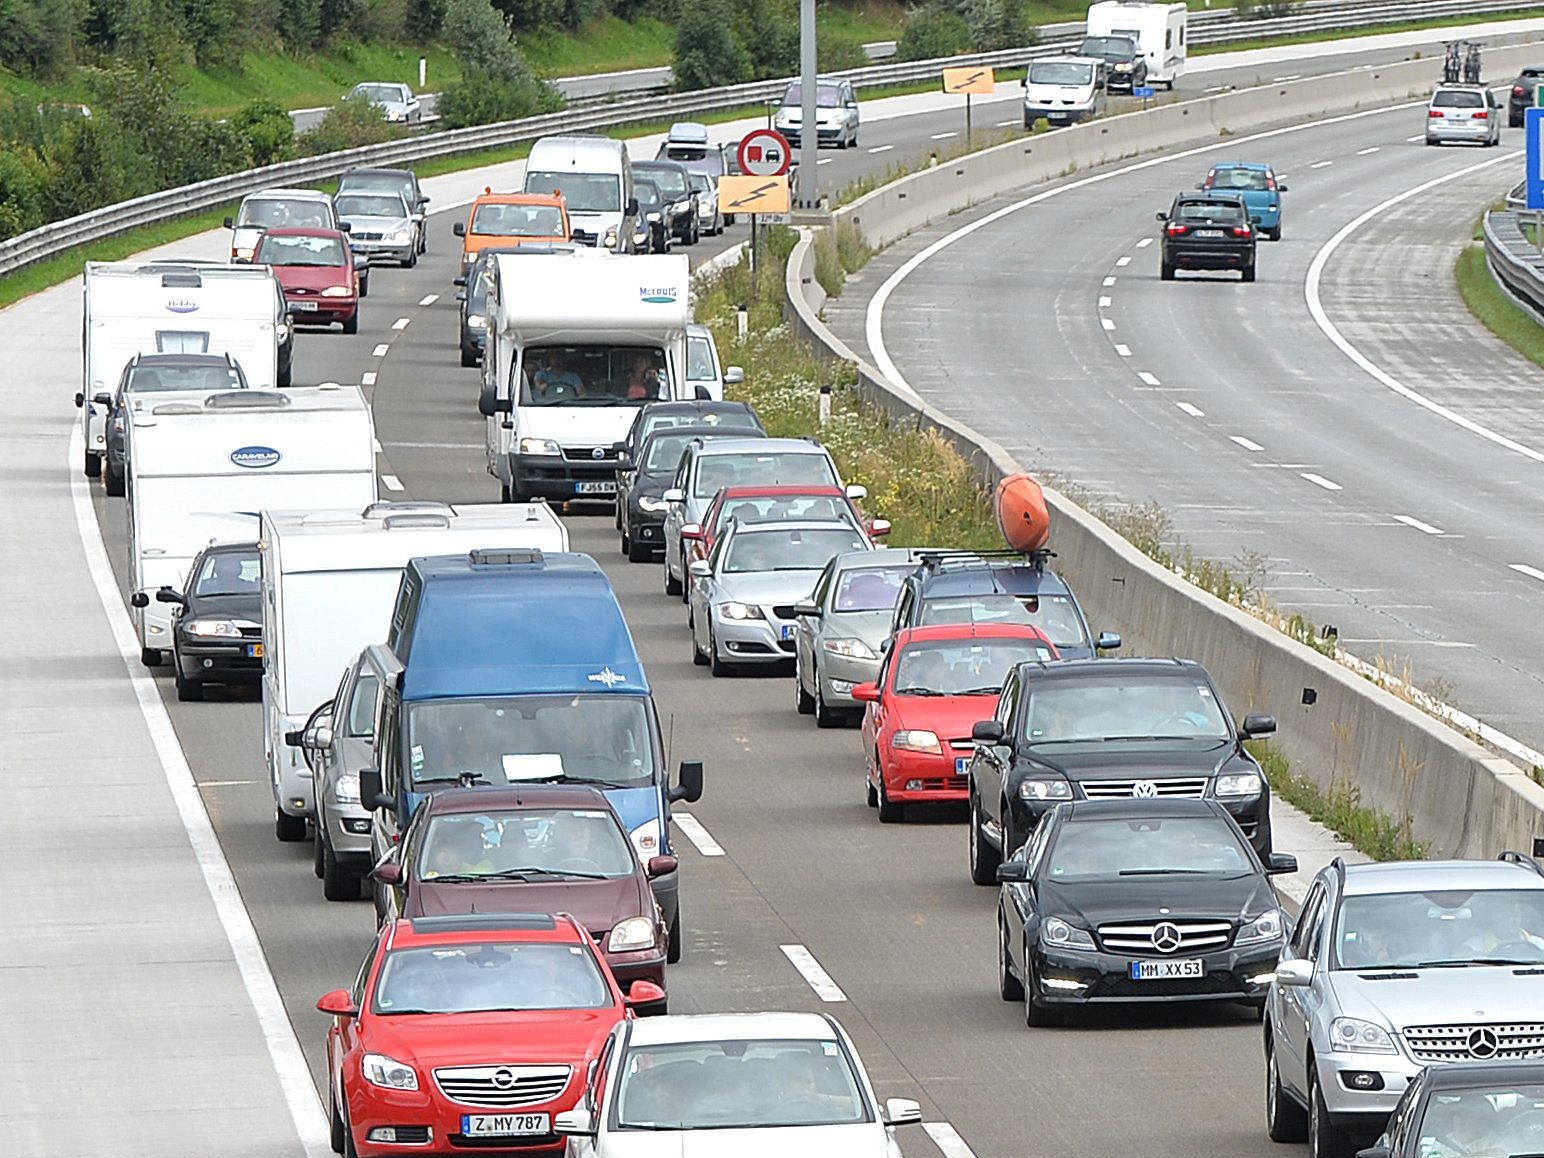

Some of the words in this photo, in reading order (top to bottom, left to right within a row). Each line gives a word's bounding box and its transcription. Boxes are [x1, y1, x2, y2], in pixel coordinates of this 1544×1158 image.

[1141, 964, 1159, 976] MM
[1165, 963, 1182, 976] XX
[1184, 962, 1200, 975] 53
[476, 1117, 485, 1131] Z
[494, 1117, 512, 1131] MY
[516, 1116, 543, 1130] 787
